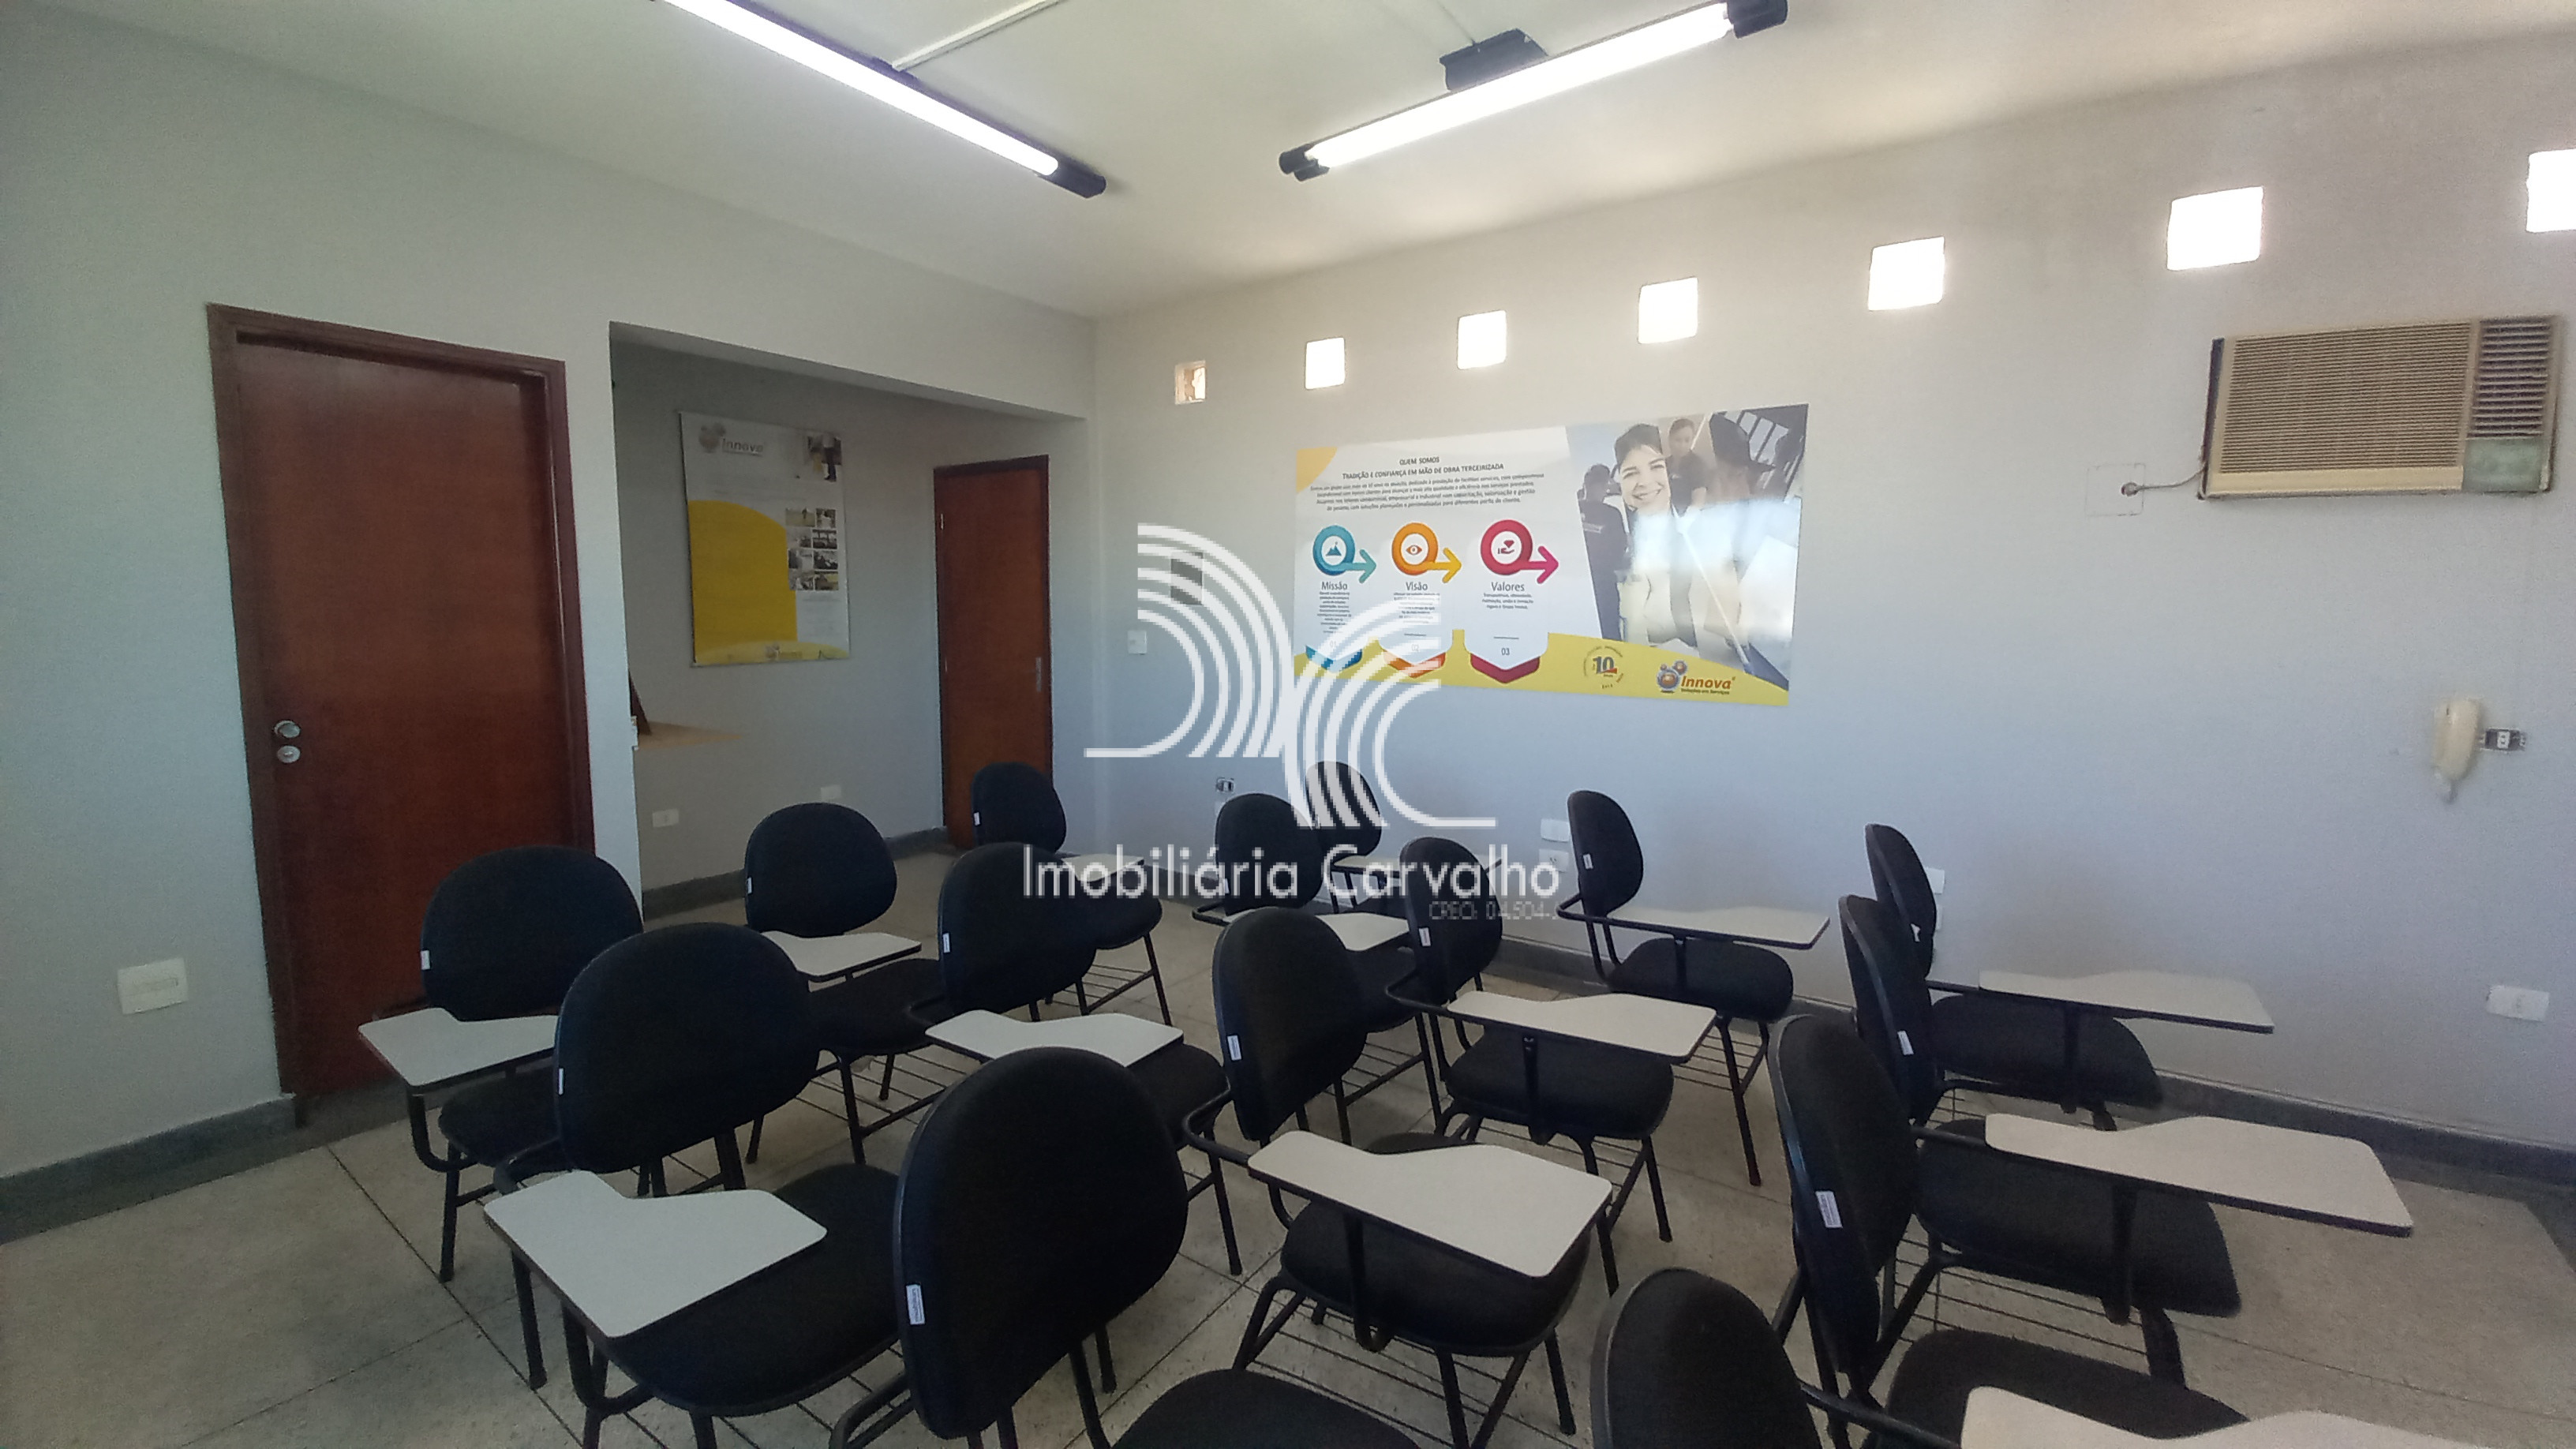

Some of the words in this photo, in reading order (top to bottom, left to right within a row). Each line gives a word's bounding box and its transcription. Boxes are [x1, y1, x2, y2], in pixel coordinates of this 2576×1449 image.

[1342, 471, 1369, 480] TRADIÇÃO
[1375, 470, 1406, 478] CONFIANÇA
[1418, 466, 1432, 475] MÃO
[1462, 463, 1503, 472] TERCEIRIZADA
[1321, 581, 1348, 590] Missão
[1406, 582, 1428, 591] Visão
[1492, 581, 1526, 592] Valores
[1501, 647, 1511, 656] 03
[1593, 656, 1615, 674] 10
